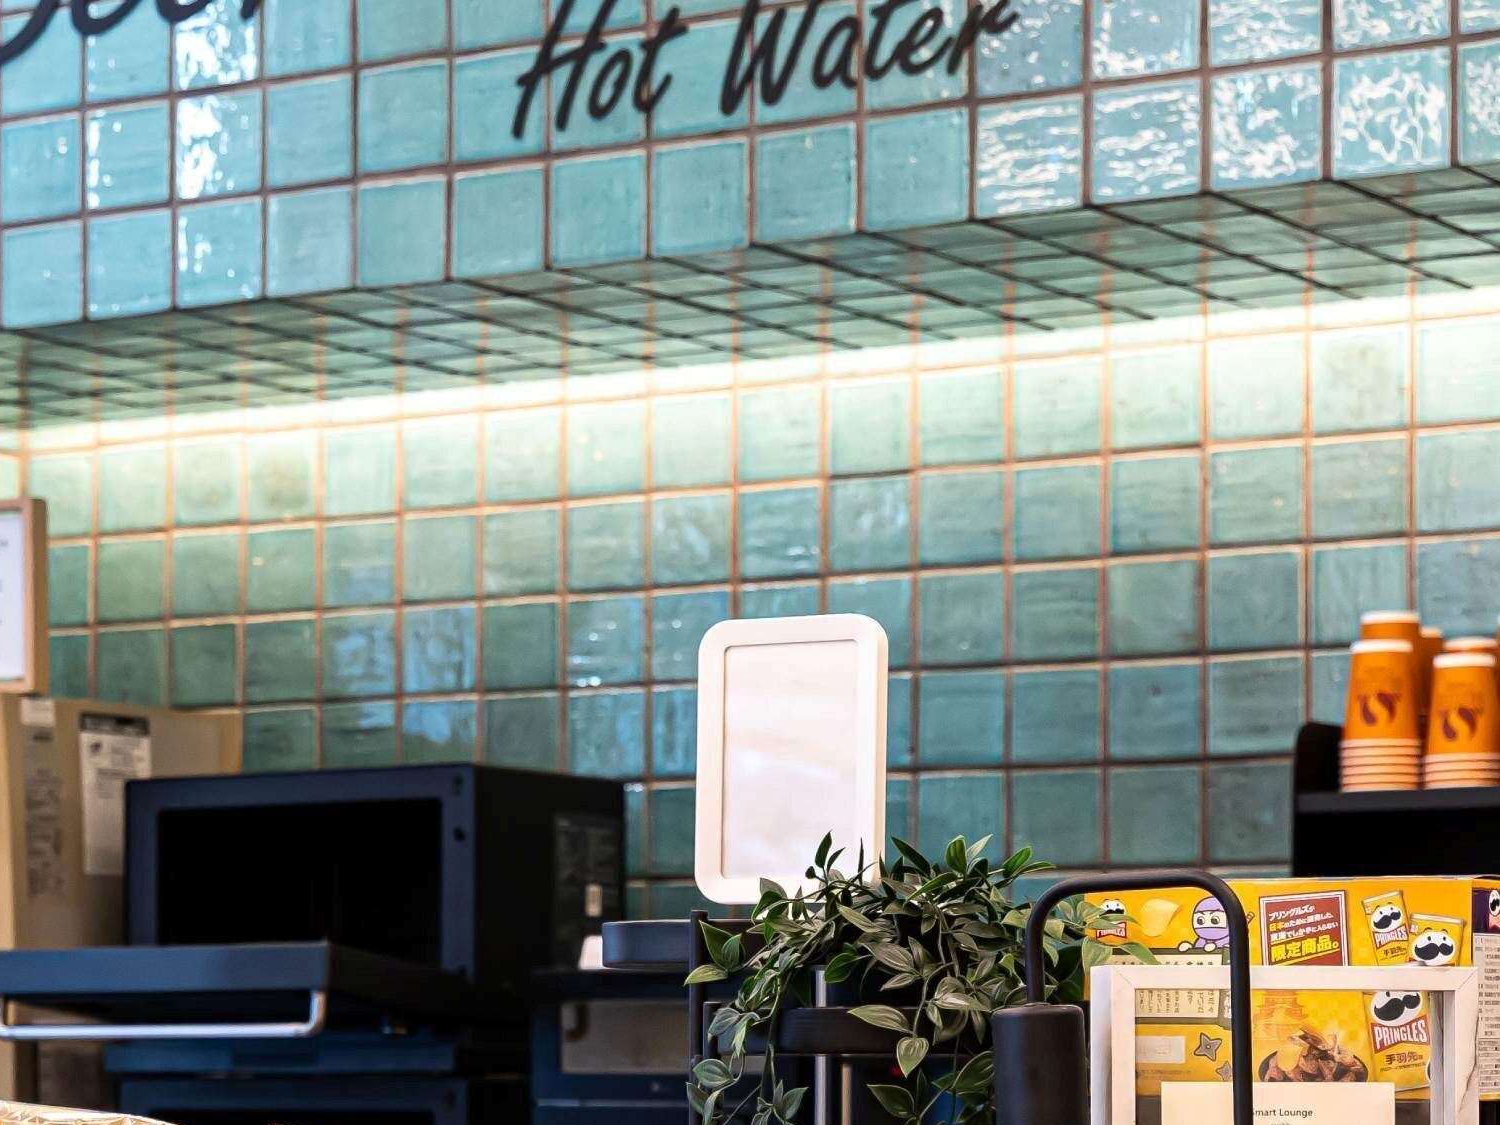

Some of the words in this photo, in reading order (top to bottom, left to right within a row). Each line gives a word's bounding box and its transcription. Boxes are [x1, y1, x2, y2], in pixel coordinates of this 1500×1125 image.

[511, 0, 687, 139] Hot
[720, 0, 1018, 116] Water
[1374, 927, 1408, 948] PRINGLES
[1373, 1019, 1428, 1050] PRINGLES
[1279, 1108, 1313, 1118] Lounge
